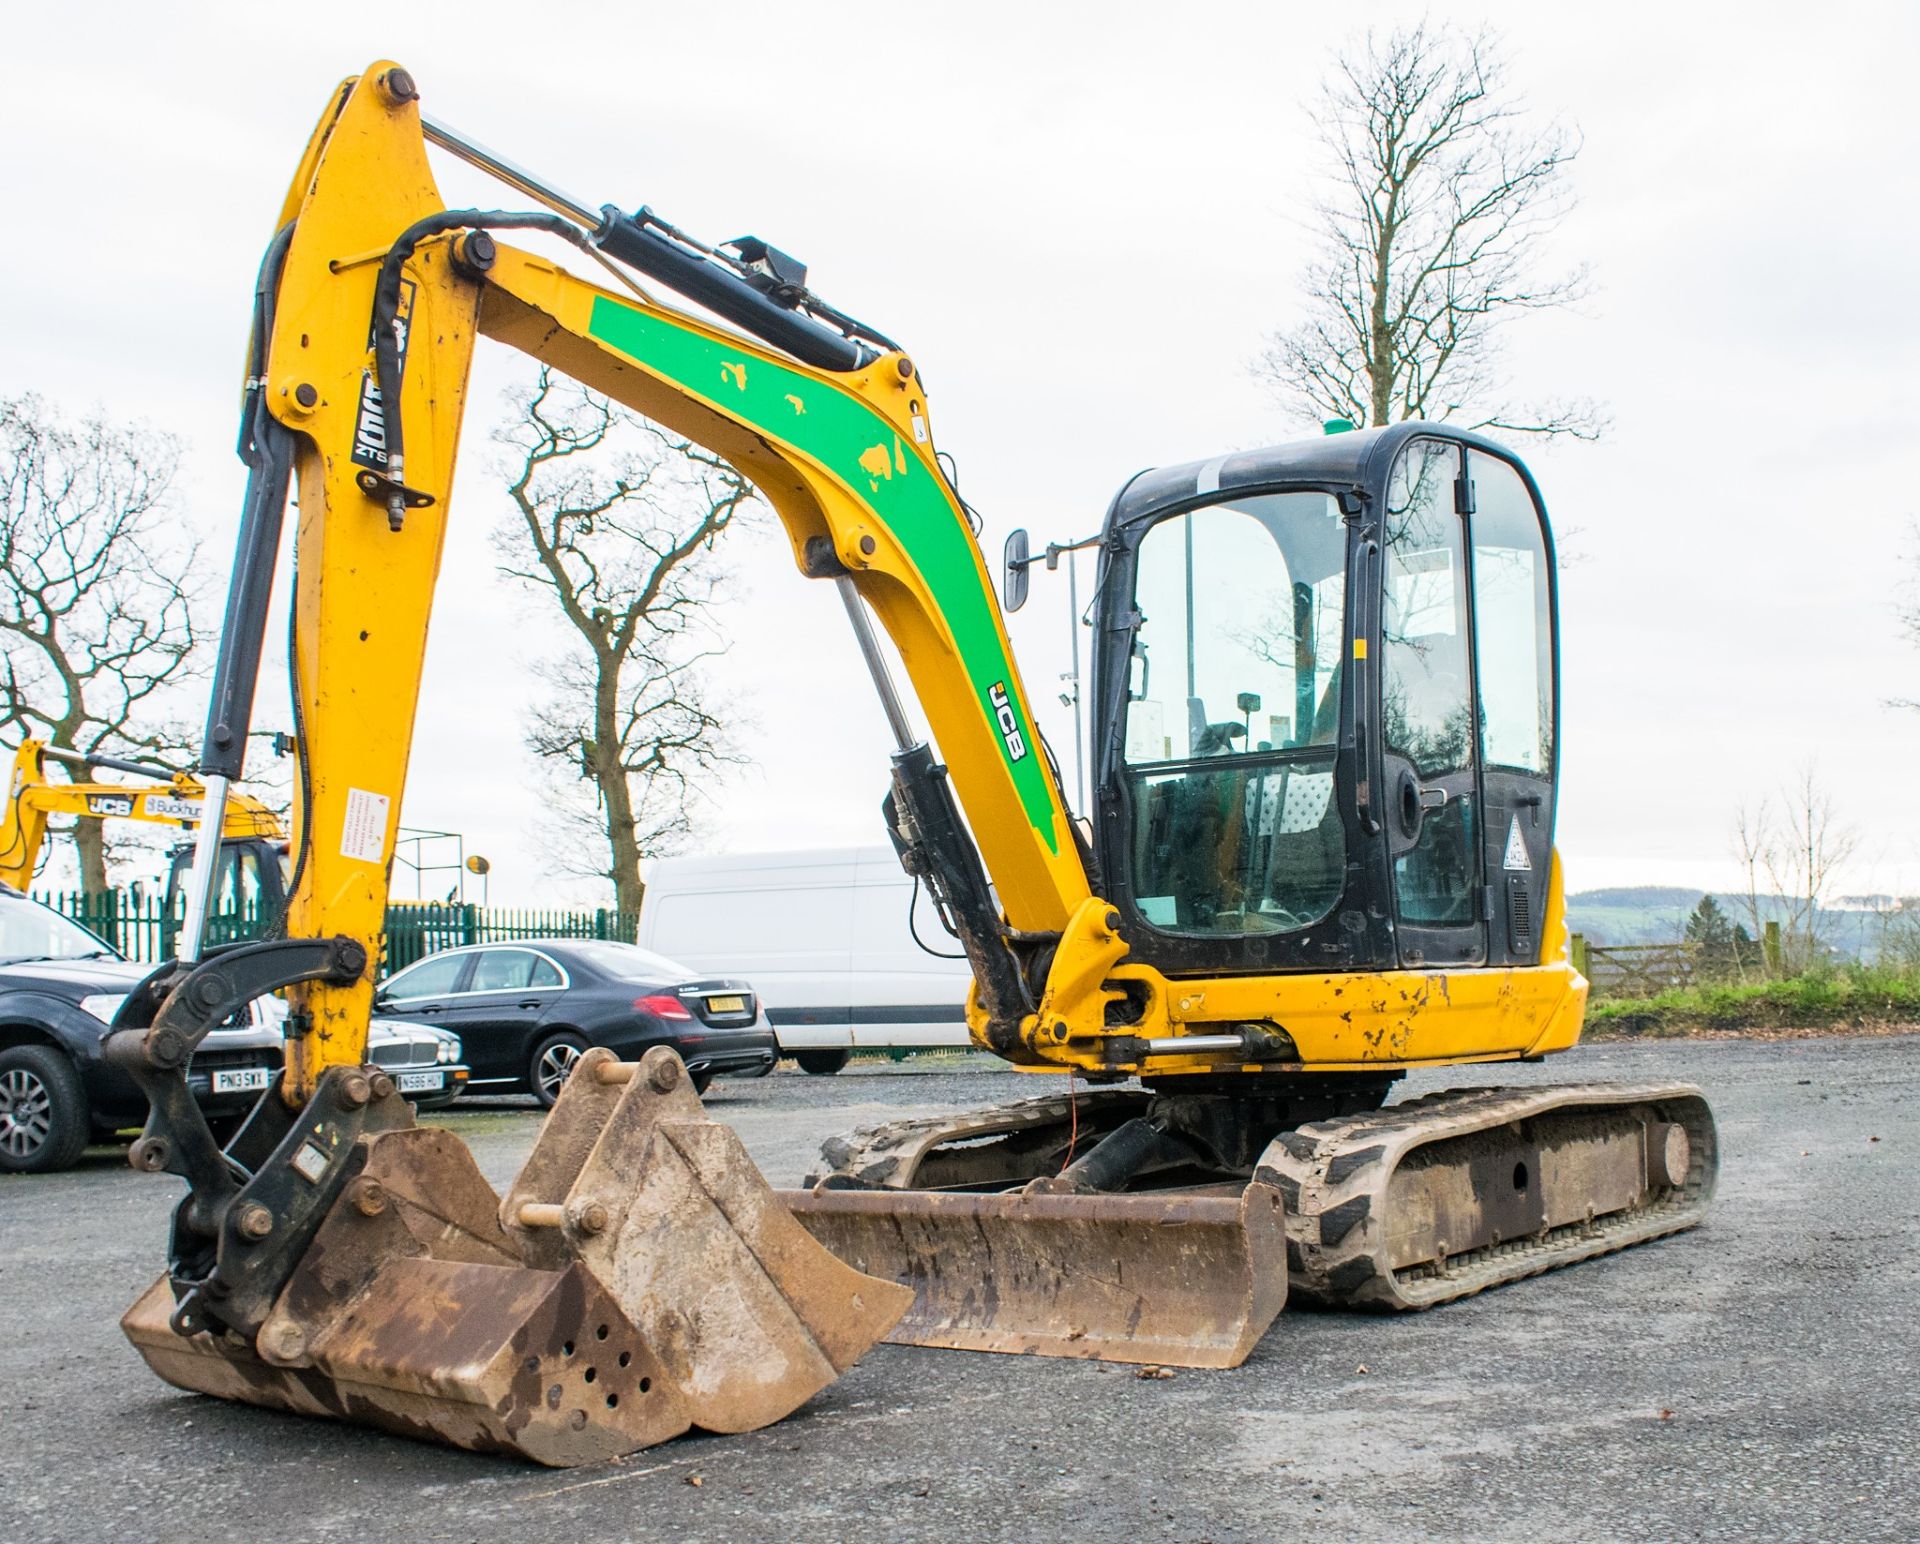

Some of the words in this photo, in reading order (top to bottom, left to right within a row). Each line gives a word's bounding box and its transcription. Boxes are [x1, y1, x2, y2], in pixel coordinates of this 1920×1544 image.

[355, 442, 388, 464] ZTS
[989, 682, 1026, 761] JCB
[90, 797, 131, 816] JCB
